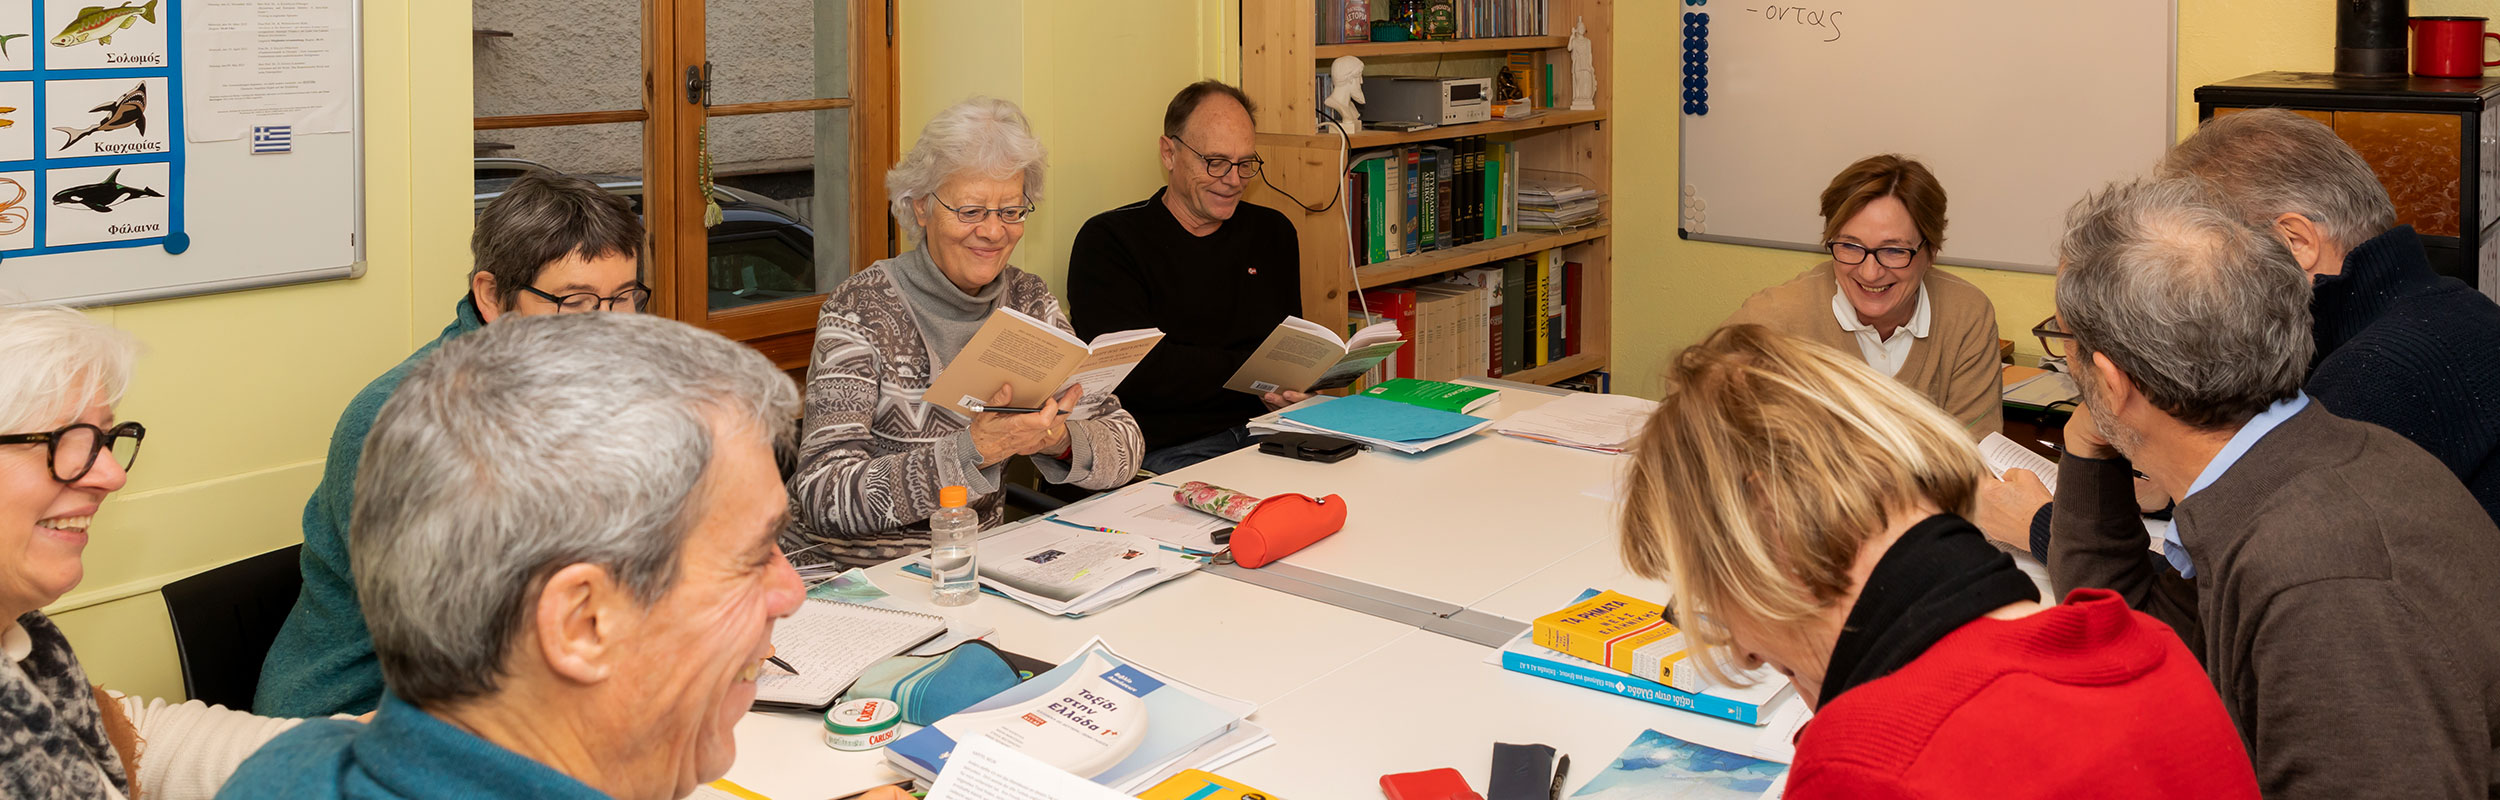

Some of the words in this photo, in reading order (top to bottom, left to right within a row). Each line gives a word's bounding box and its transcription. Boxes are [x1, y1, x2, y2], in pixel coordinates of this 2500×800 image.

[1746, 5, 1843, 42] -οντας
[106, 52, 161, 65] Σολωμός
[94, 139, 161, 154] Καρχαρίας
[1468, 204, 1473, 214] 2
[108, 223, 160, 235] Φάλαινα
[1577, 600, 1629, 621] ΡΗΜΑΤΑ
[1078, 688, 1118, 712] Ταξίδι
[1627, 685, 1654, 700] Ελλάδα
[1654, 690, 1672, 702] στην
[1063, 697, 1098, 715] στην
[1672, 694, 1695, 709] Ταξίδι
[856, 701, 879, 722] CARUSO
[1048, 702, 1100, 731] Ελλάδα
[868, 730, 894, 745] CARUSO
